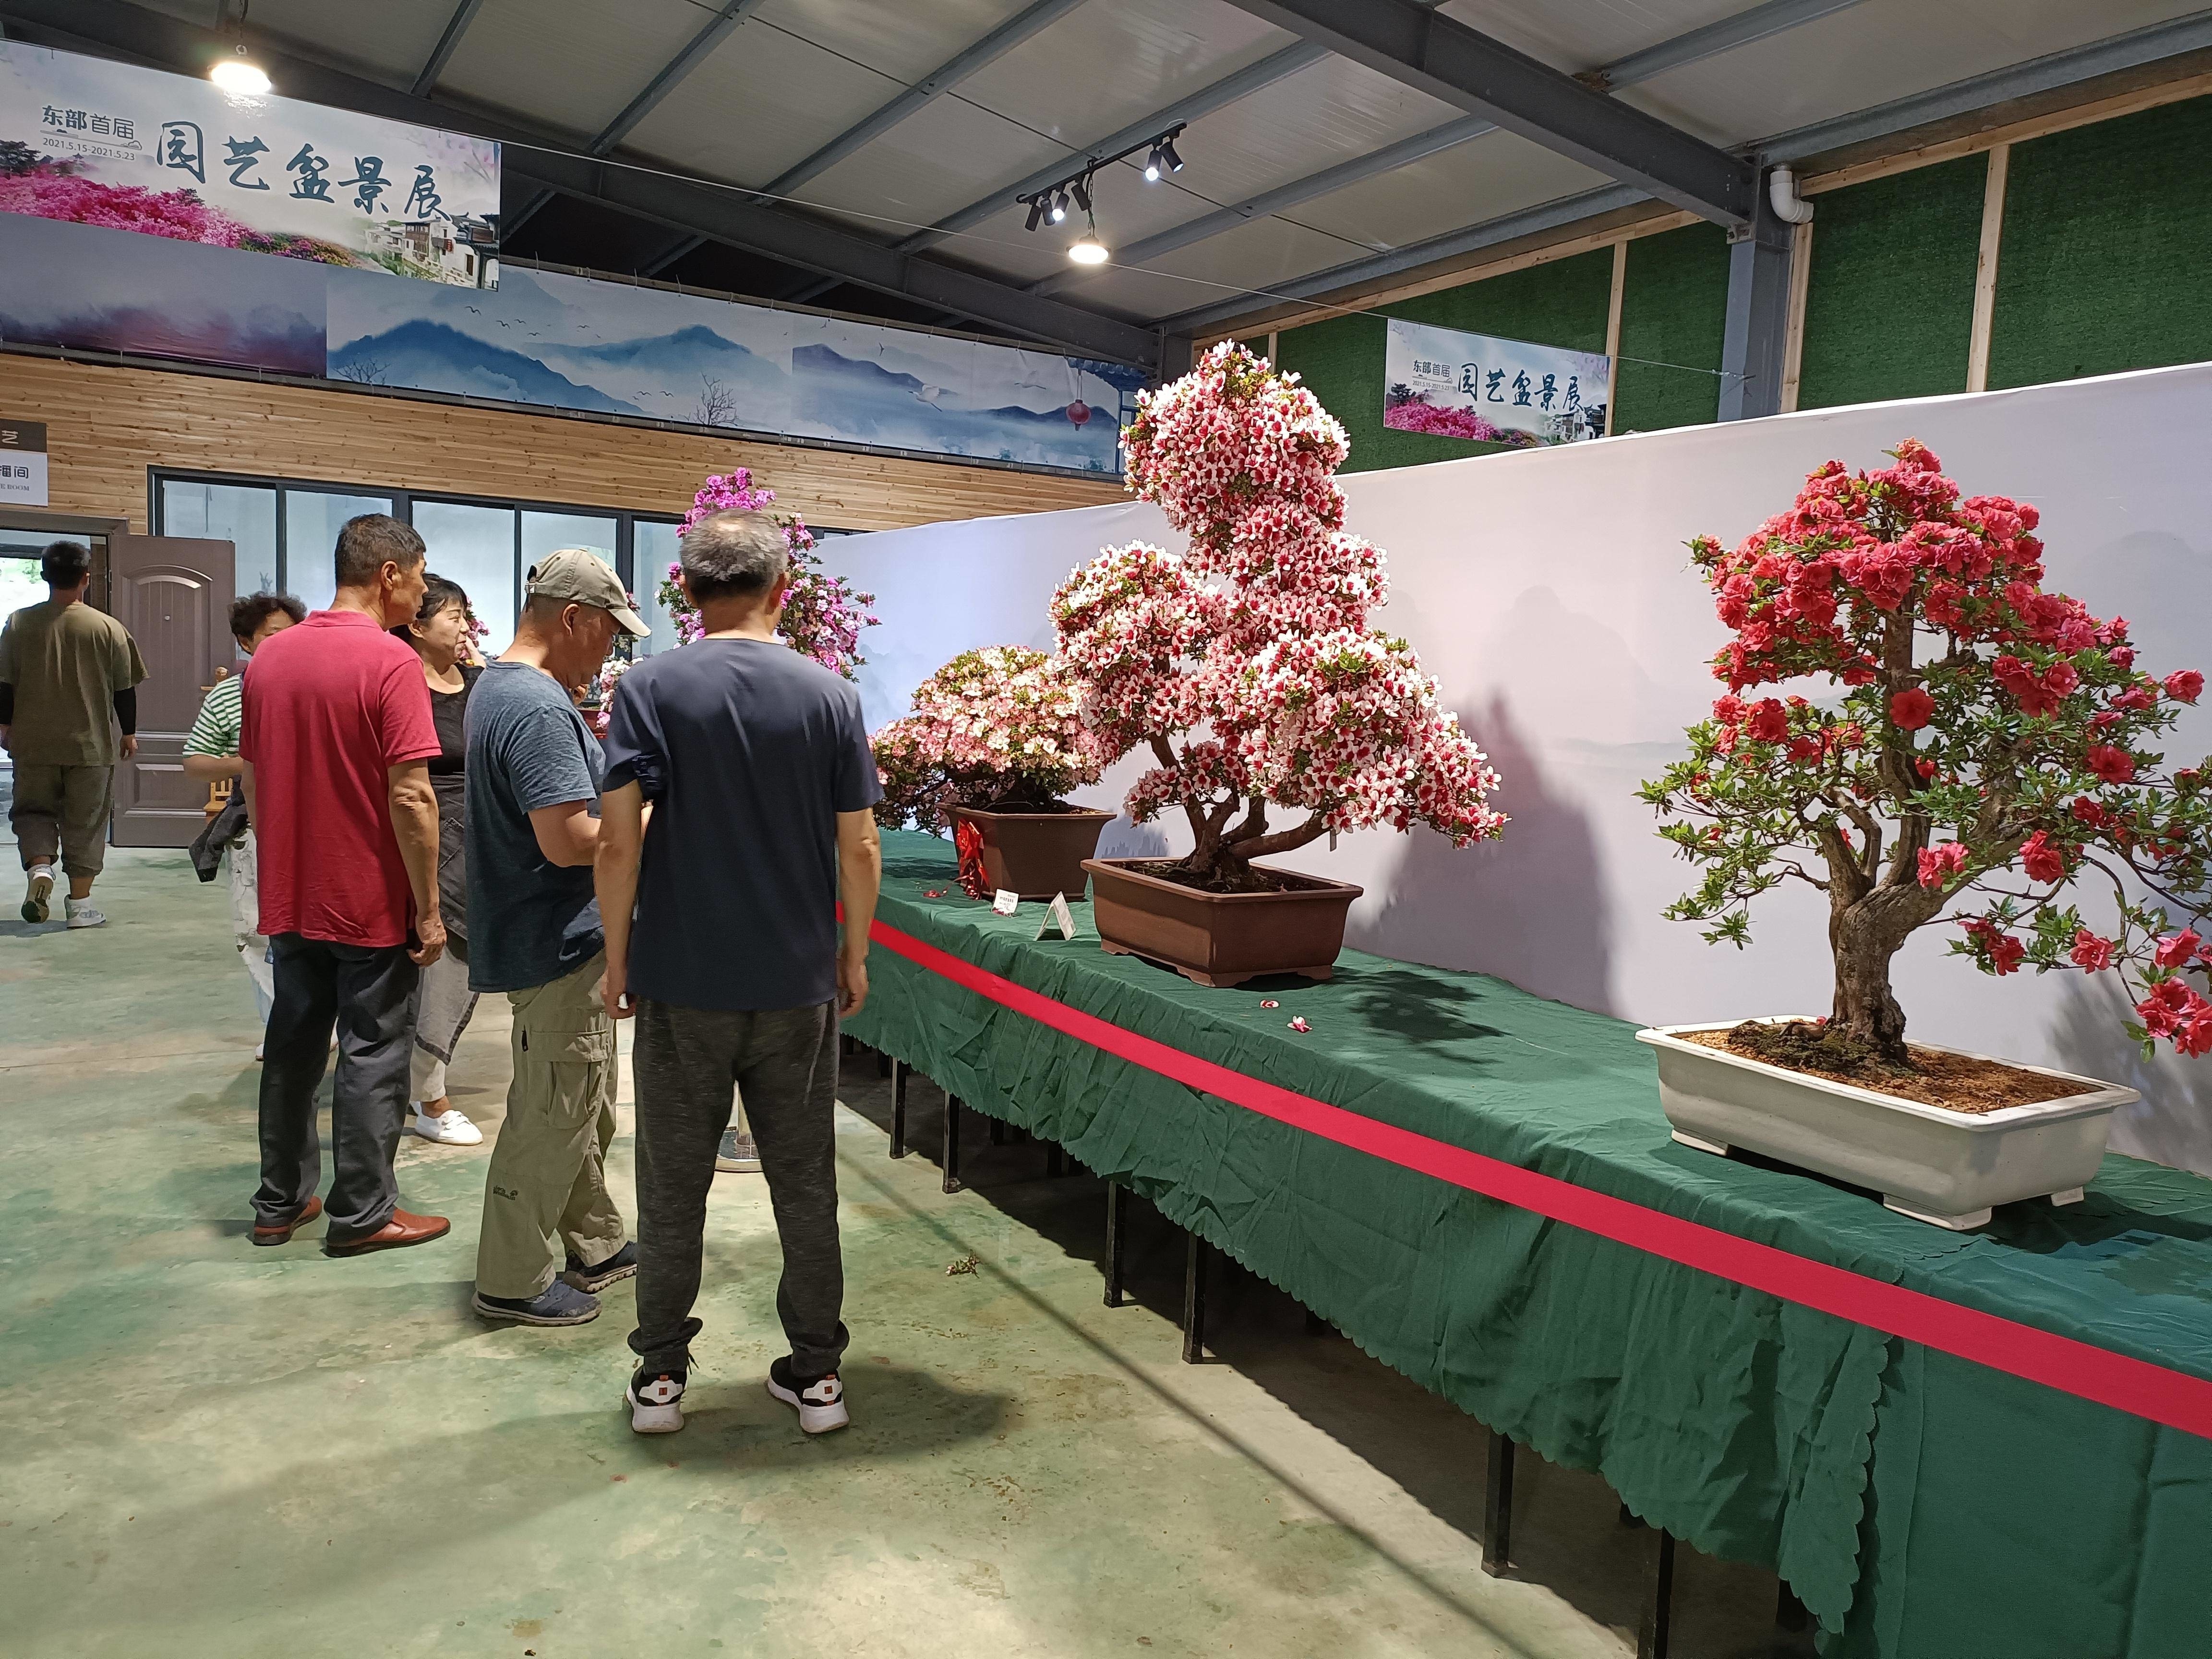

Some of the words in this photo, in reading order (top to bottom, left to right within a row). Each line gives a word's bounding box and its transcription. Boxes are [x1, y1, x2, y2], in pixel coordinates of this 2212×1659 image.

[42, 105, 133, 140] 东部首届
[43, 137, 135, 161] 2021.5.15-2021.5.23
[156, 121, 452, 221] 园艺盆景展
[1413, 360, 1450, 378] 东部首届
[1458, 362, 1585, 412] 园艺盆景展
